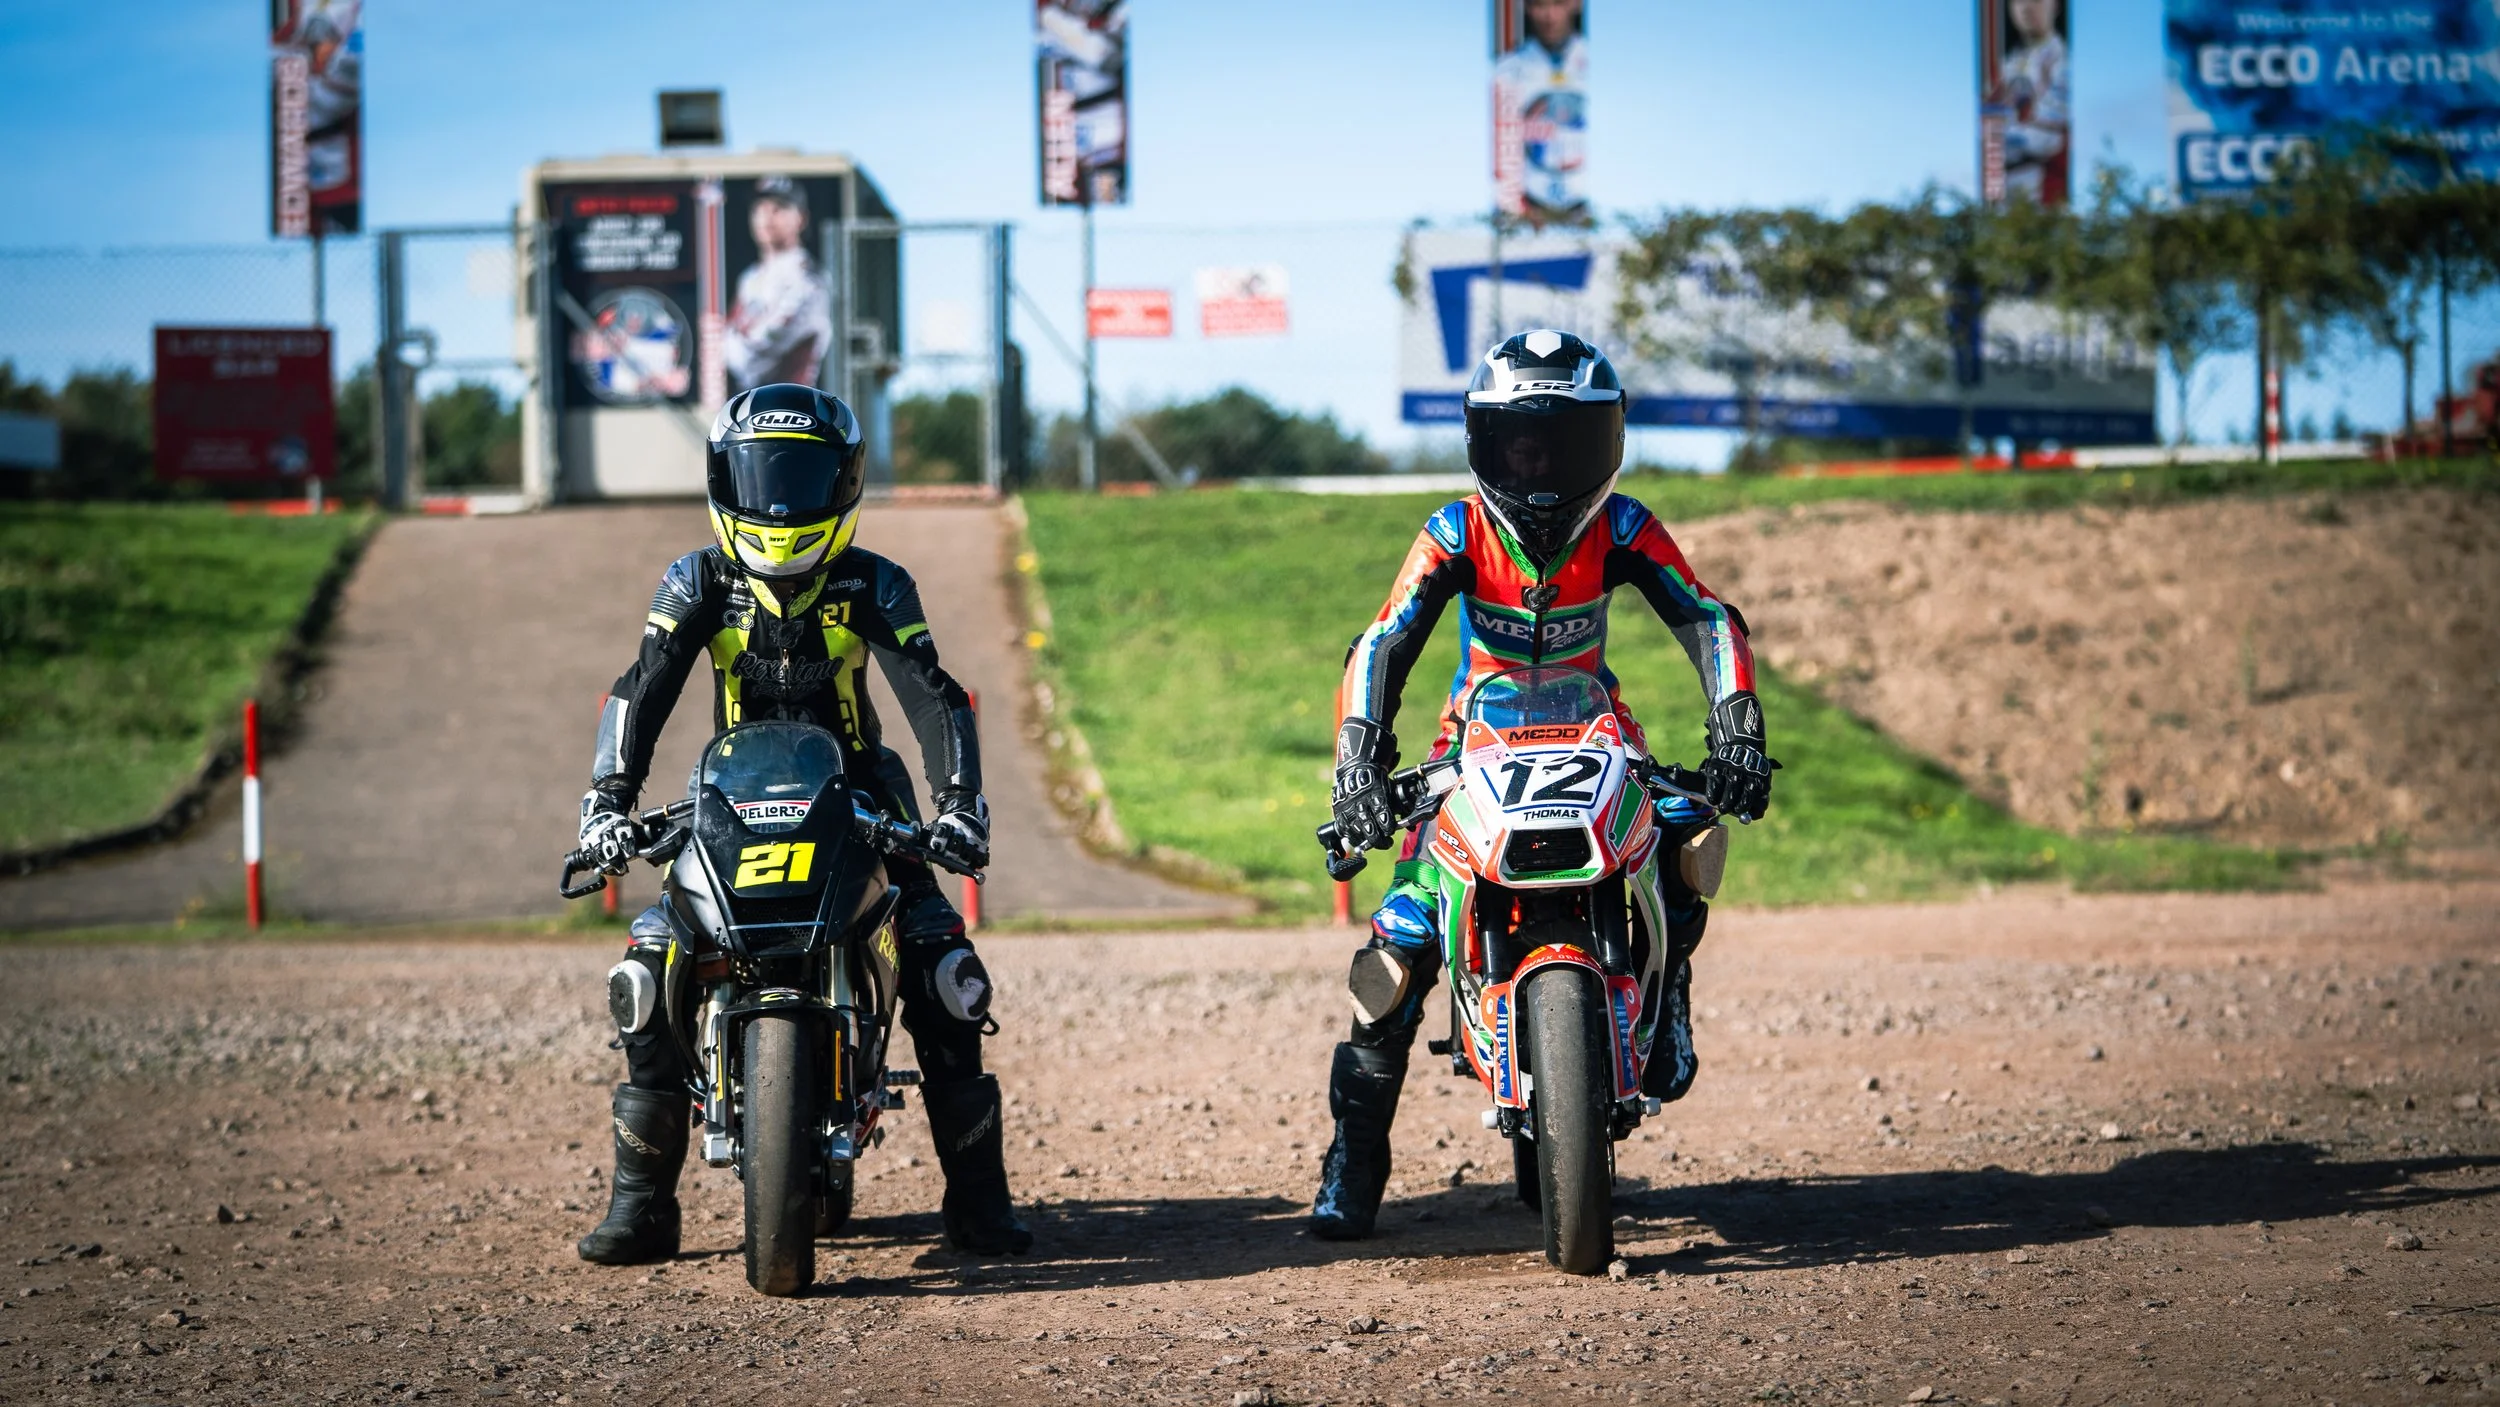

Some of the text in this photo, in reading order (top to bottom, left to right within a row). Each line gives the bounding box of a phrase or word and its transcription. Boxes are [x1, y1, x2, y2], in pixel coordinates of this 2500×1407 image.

[2361, 14, 2388, 29] to
[2393, 12, 2433, 29] the
[2200, 45, 2472, 87] ECCO Arena
[1512, 382, 1577, 393] LS2
[757, 415, 808, 426] HJC
[828, 579, 862, 591] MEDD
[822, 601, 850, 627] 21
[1474, 610, 1590, 642] MEDD
[1549, 621, 1597, 653] Racing
[1508, 728, 1580, 742] MEDD
[1500, 755, 1603, 808] 12
[739, 806, 806, 820] DELLORTO
[1523, 809, 1580, 822] THOMAS
[734, 842, 817, 889] 21
[615, 1117, 661, 1155] RST
